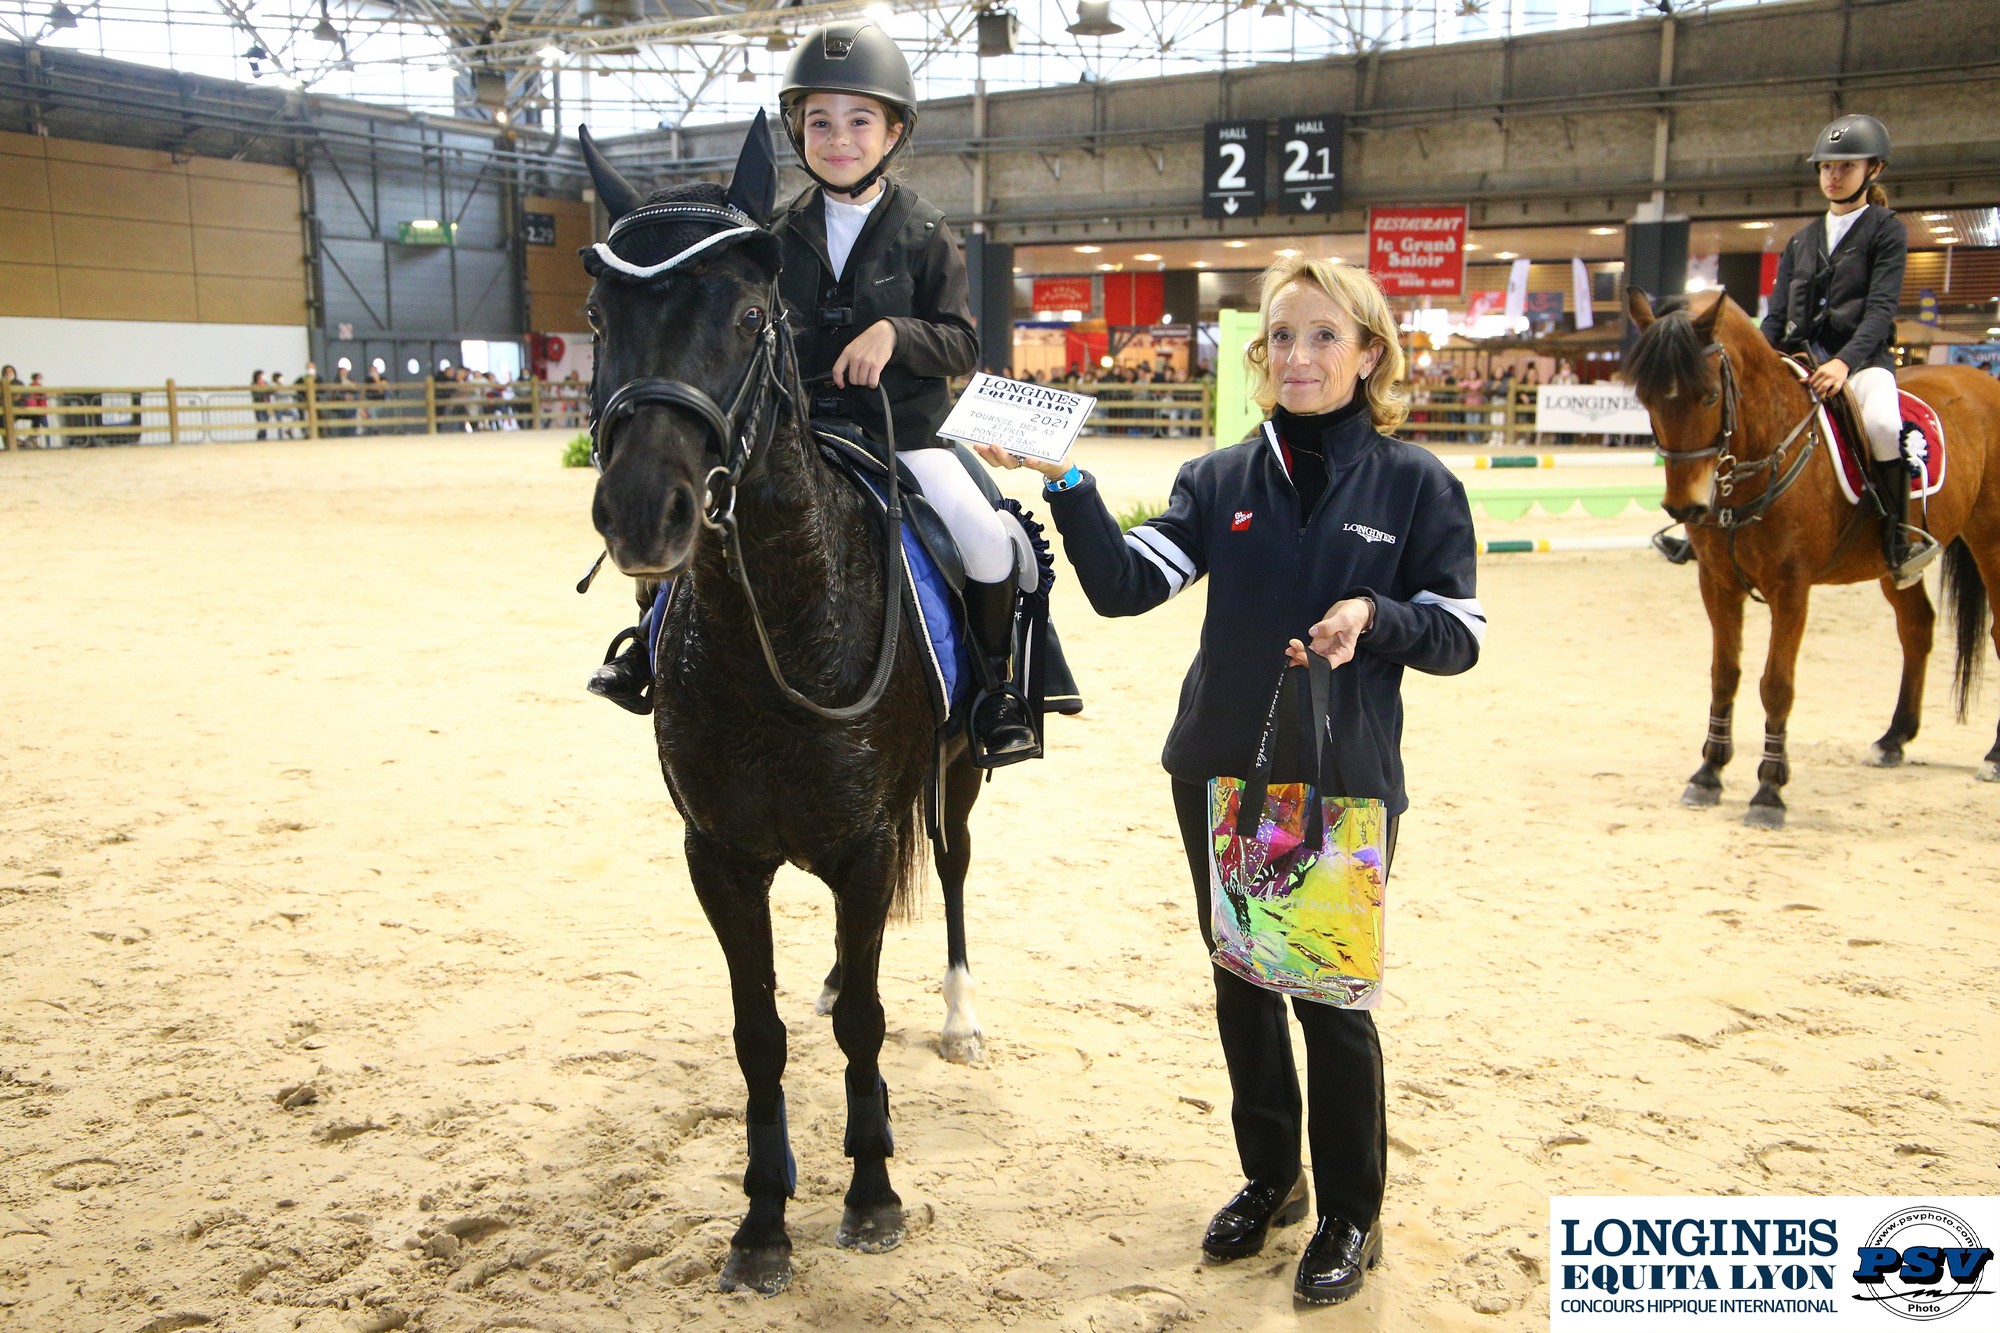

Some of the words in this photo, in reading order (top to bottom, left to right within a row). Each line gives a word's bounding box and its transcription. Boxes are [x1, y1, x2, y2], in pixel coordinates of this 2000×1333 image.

[1219, 127, 1248, 140] HALL
[1295, 120, 1326, 135] HALL
[1217, 142, 1247, 189] 2
[1283, 139, 1336, 182] 2.1
[1373, 217, 1464, 231] RESTAURANT
[1376, 237, 1394, 252] le
[1401, 235, 1456, 252] Grand
[1388, 252, 1444, 268] Saloir
[981, 377, 1081, 407] LONGINES
[977, 387, 1033, 406] EQUITA
[1036, 400, 1075, 414] LYON
[1018, 422, 1038, 432] DES
[1041, 427, 1056, 436] AS
[1030, 413, 1069, 429] 2021
[973, 426, 1003, 439] PONEY
[1002, 426, 1027, 436] PRIX
[1343, 523, 1396, 544] LONGINES
